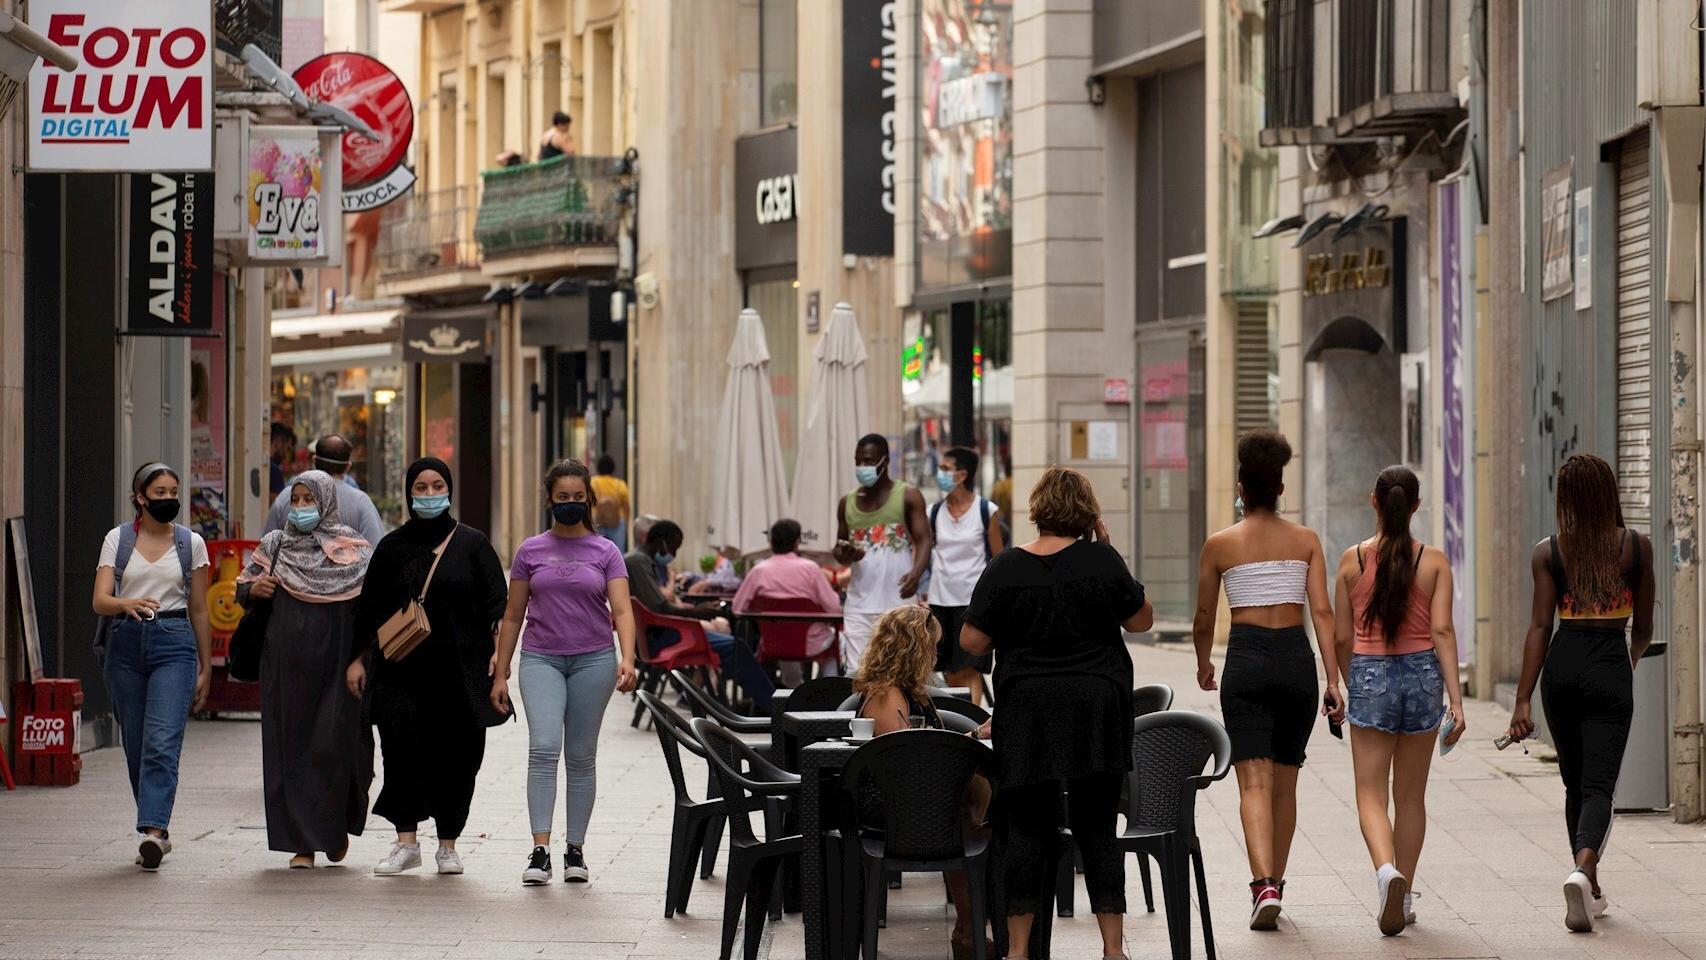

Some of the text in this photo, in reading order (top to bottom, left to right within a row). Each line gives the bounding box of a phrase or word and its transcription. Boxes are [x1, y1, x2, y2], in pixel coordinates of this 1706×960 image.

[42, 14, 207, 69] FOTO
[41, 74, 203, 129] LLUM
[41, 119, 130, 137] DIGITAL
[182, 192, 195, 230] roba
[254, 183, 319, 235] Eva
[341, 181, 399, 209] TXOCA
[756, 174, 792, 225] casa
[22, 715, 65, 731] FOTO
[22, 730, 65, 746] LLUM
